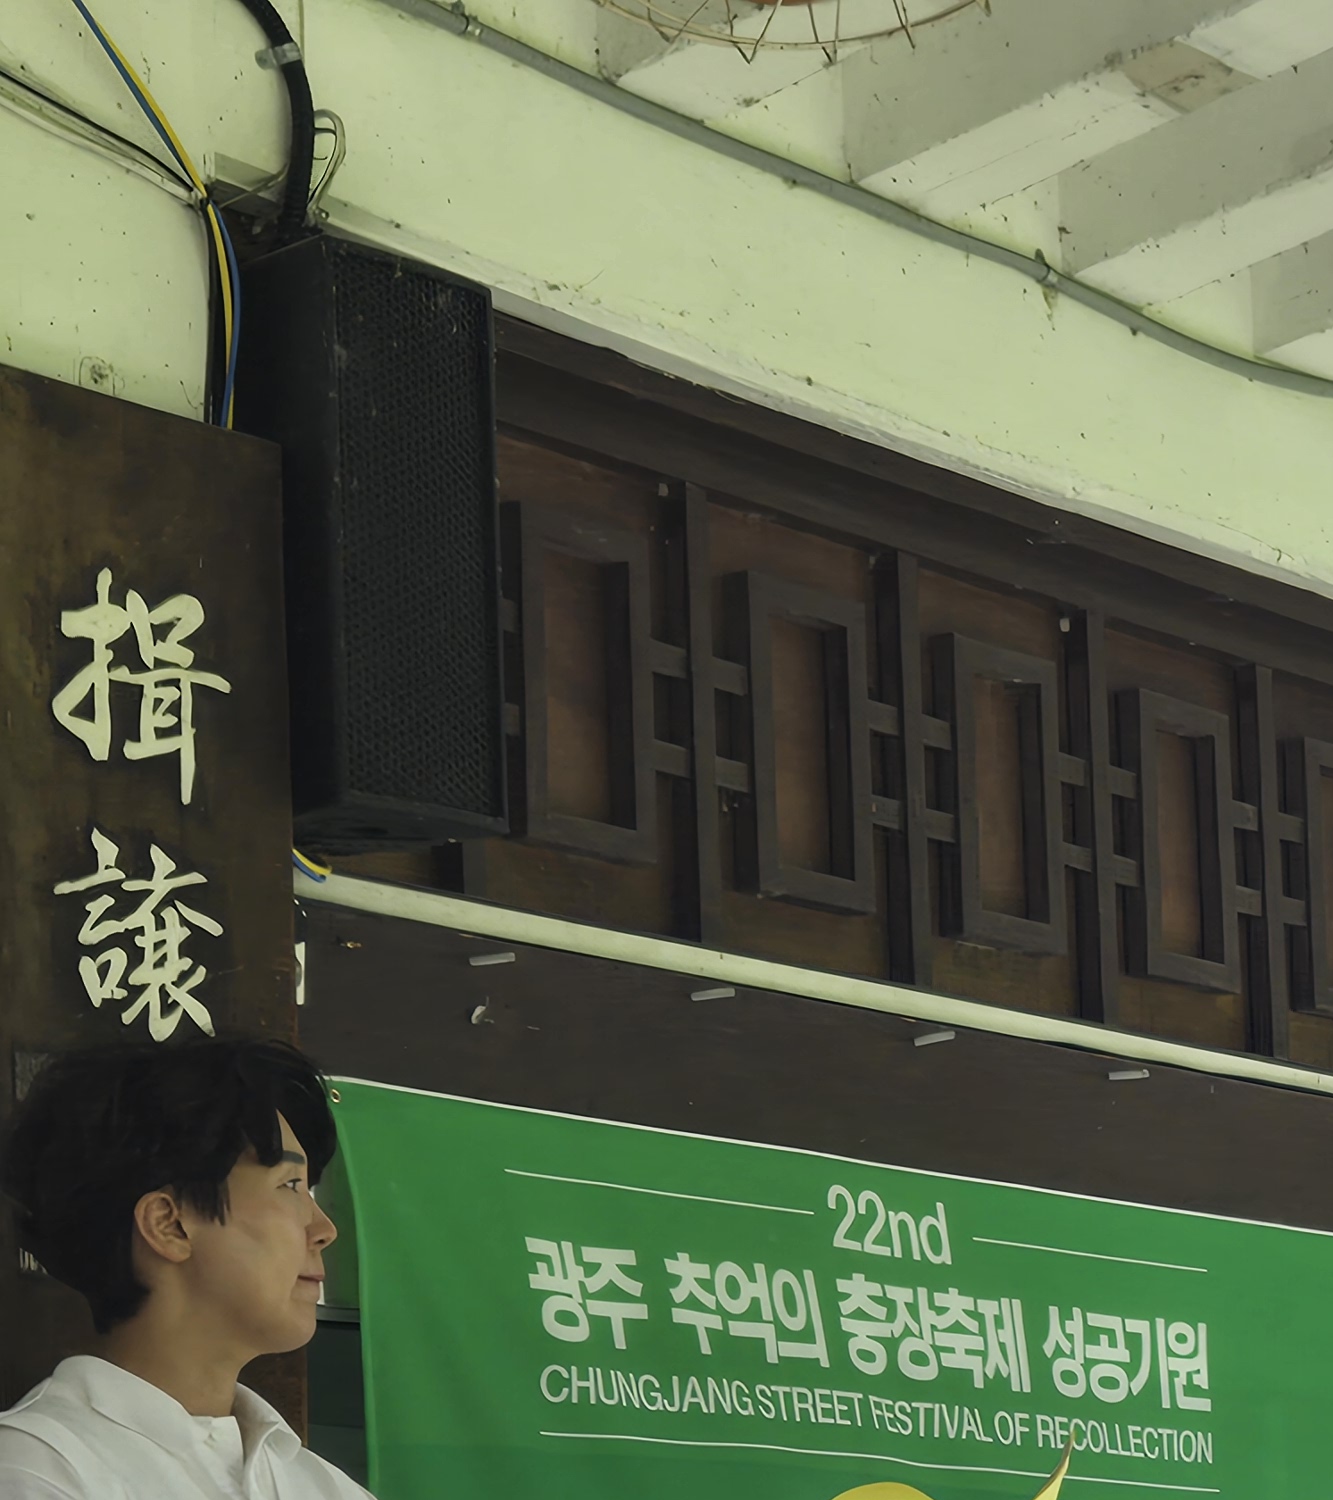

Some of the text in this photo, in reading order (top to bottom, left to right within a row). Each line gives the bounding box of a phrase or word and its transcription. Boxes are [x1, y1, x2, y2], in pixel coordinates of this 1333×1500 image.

[827, 1184, 953, 1265] 22nd
[525, 1236, 1212, 1412] 광주 추억의 충장축제 성공기원
[540, 1364, 1213, 1464] CHUNGJANG STREET FESTIVAL OF RECOLLECTION
